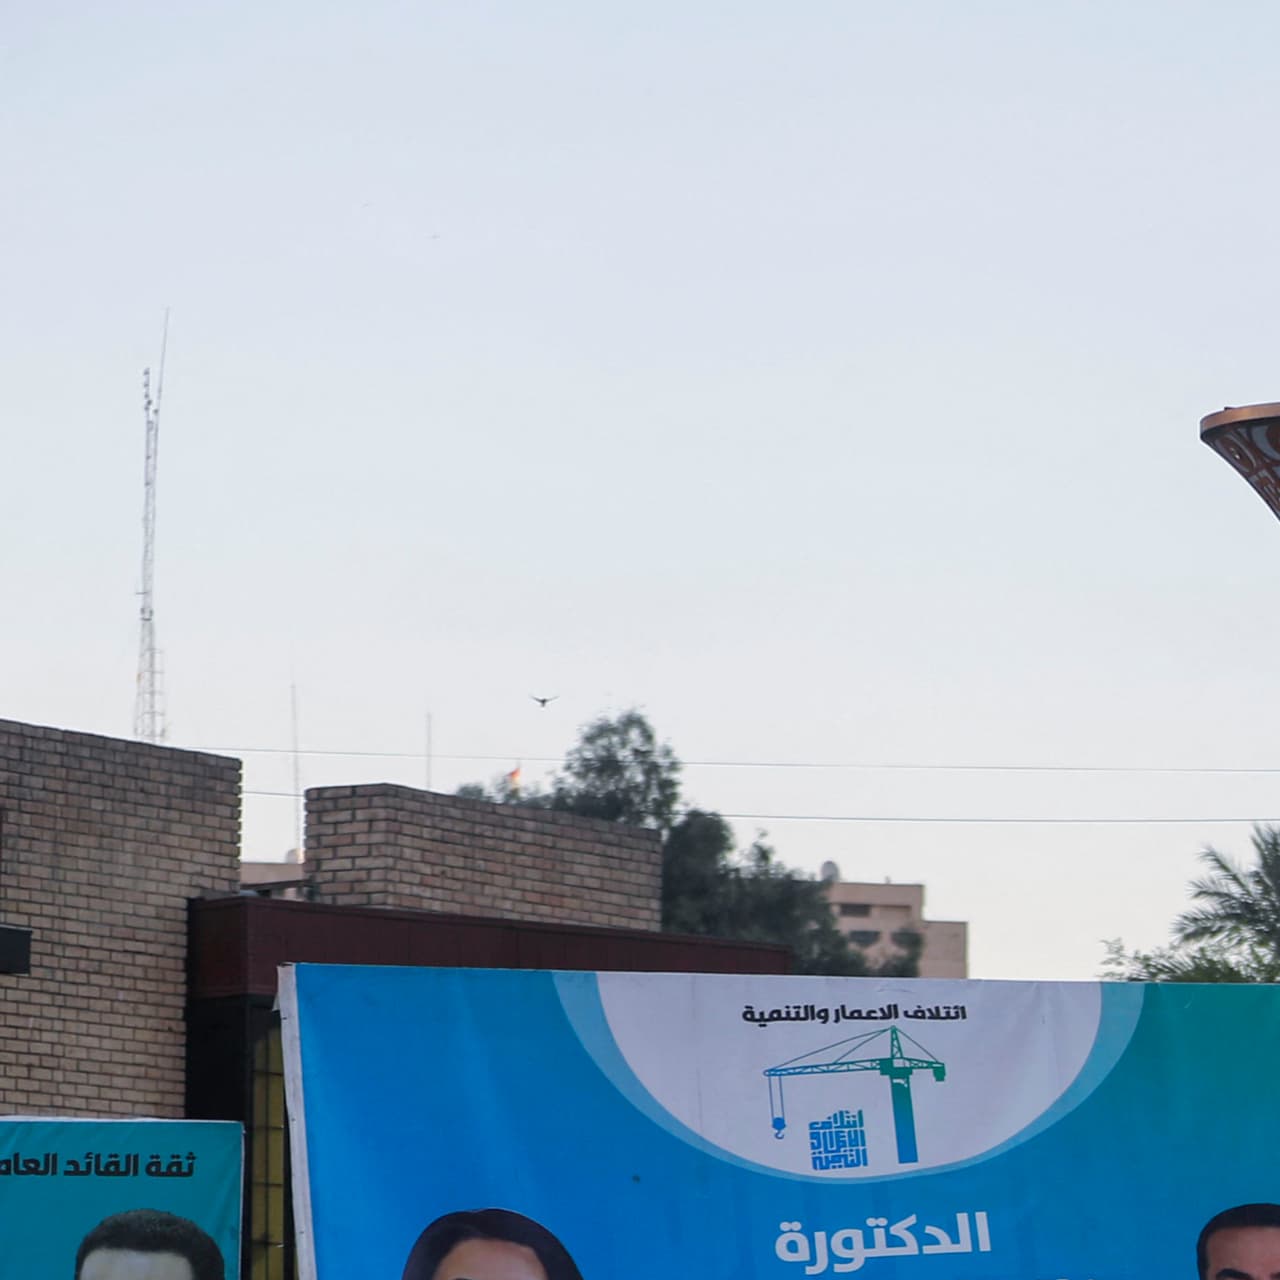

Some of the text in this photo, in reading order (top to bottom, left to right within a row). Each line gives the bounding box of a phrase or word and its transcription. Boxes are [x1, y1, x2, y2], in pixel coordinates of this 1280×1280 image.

[742, 1004, 829, 1027] والتنمية
[63, 1152, 139, 1178] القائد
[145, 1152, 197, 1178] ثقة
[774, 1211, 991, 1276] الدكتورة
